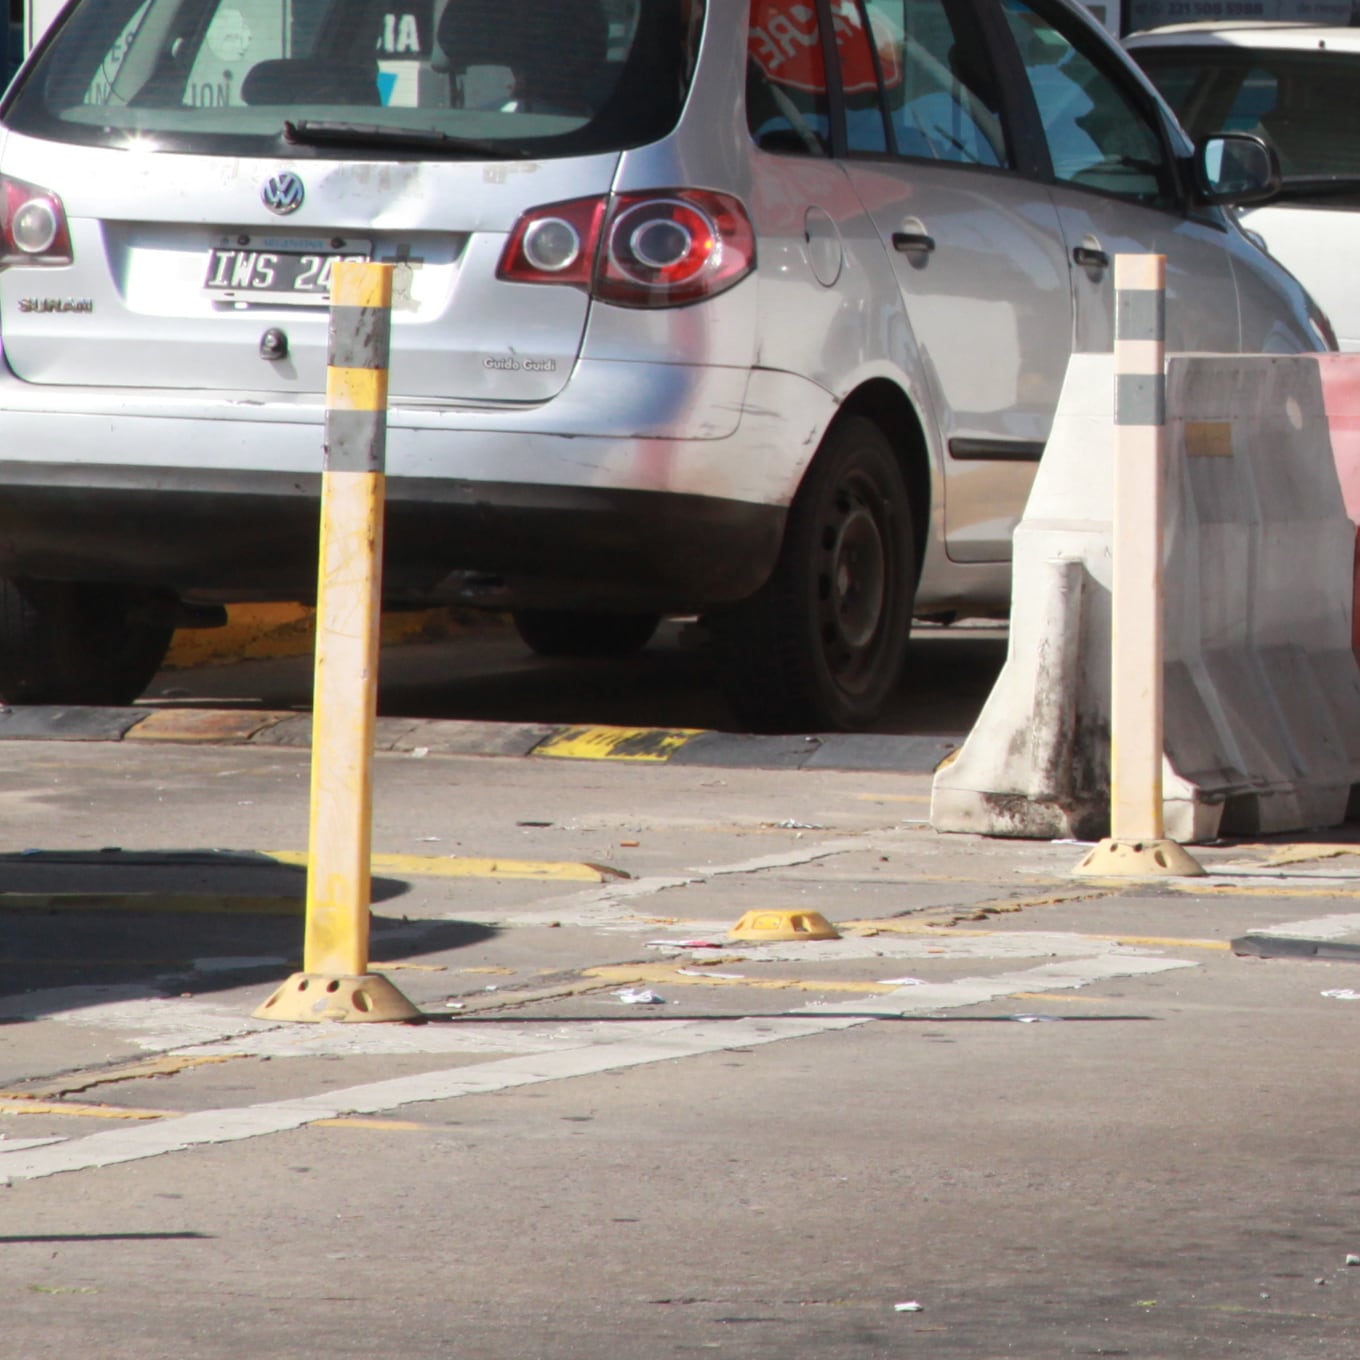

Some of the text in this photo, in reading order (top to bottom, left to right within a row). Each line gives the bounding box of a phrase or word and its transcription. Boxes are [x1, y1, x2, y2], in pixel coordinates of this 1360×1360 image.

[208, 250, 278, 288] IWS
[483, 358, 556, 371] Guido Guidi
